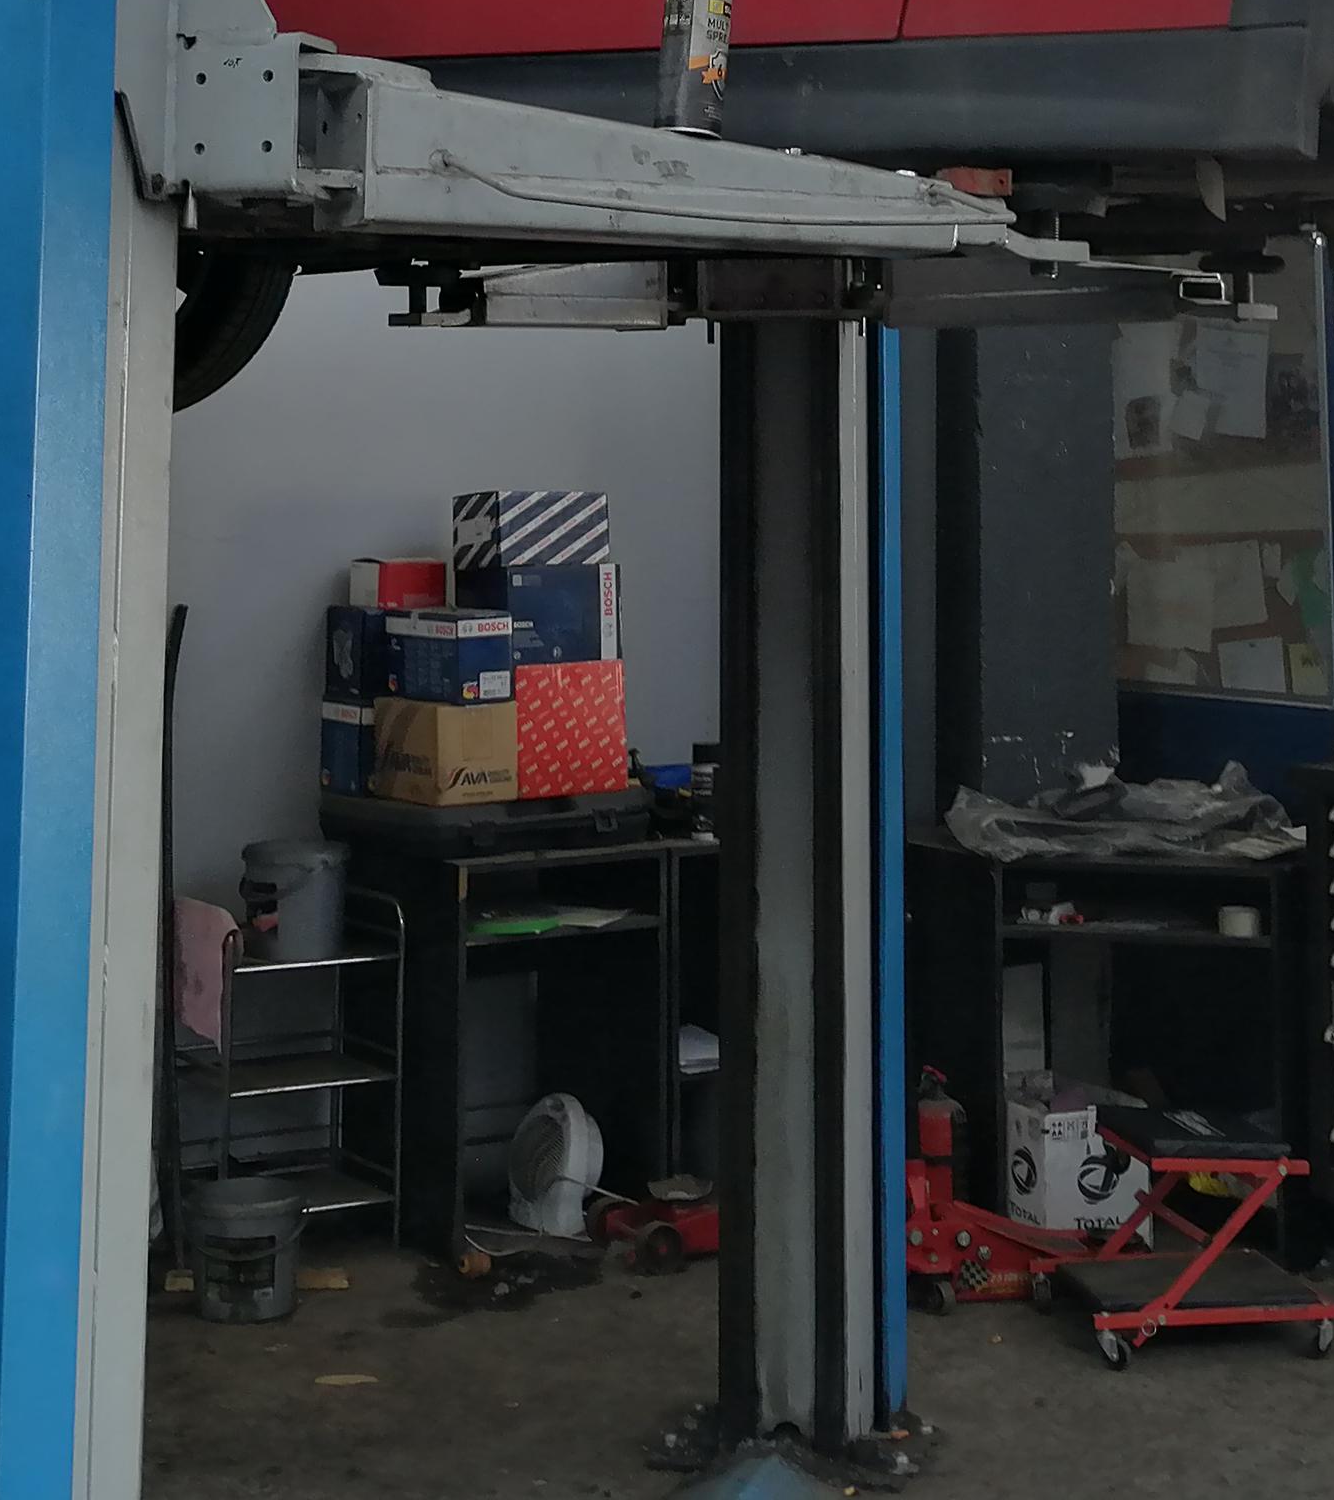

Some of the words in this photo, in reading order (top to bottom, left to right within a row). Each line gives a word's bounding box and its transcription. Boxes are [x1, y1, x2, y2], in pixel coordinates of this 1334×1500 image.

[603, 571, 613, 616] BOSCH
[477, 621, 509, 632] BOSCH
[1009, 1200, 1042, 1225] TOTAL
[1075, 1215, 1123, 1231] TOTAL
